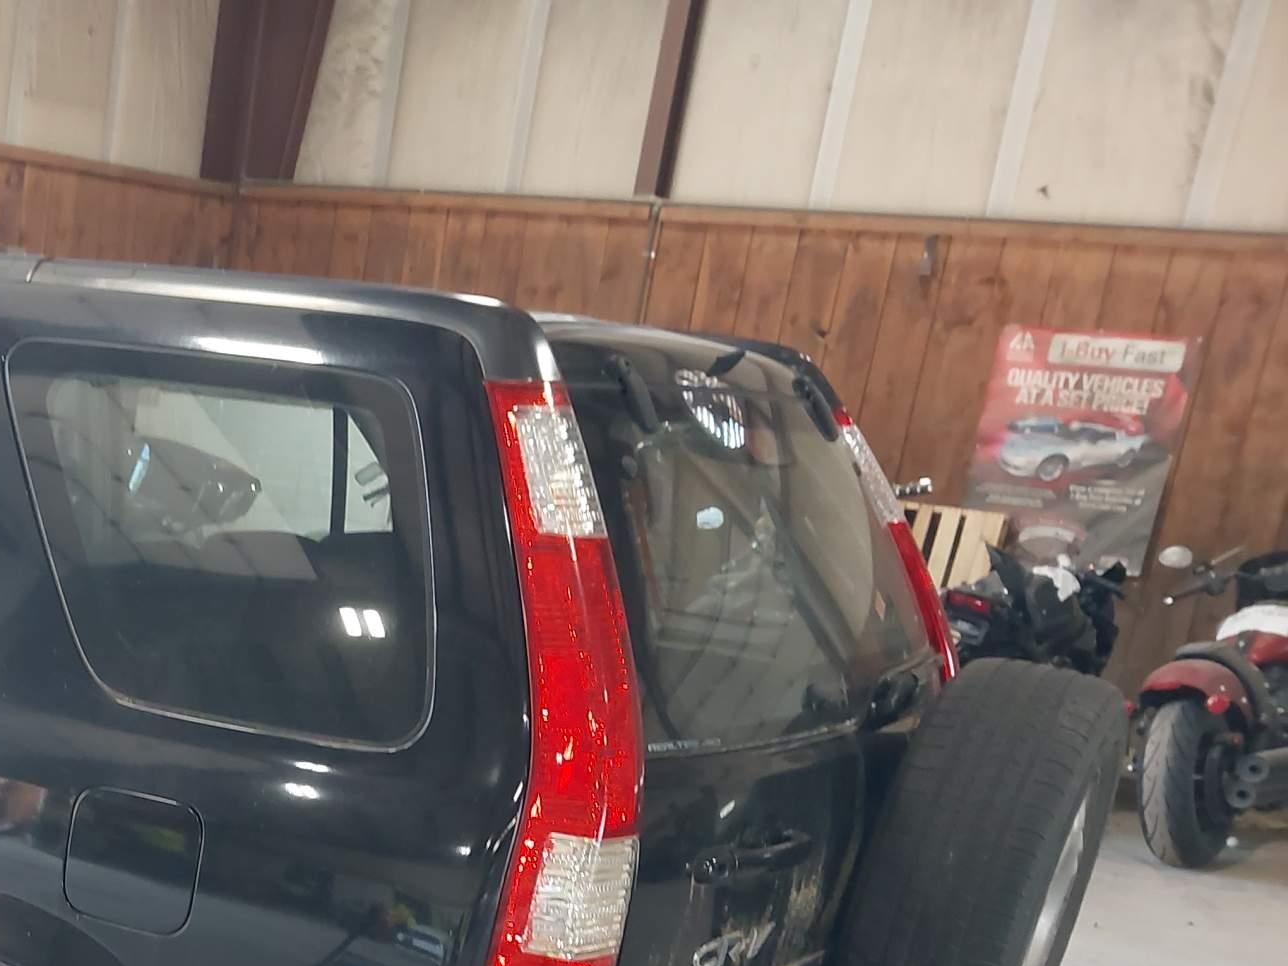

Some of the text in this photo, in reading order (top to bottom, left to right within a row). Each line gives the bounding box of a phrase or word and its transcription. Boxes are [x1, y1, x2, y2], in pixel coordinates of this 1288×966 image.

[1122, 343, 1167, 366] Fast
[1007, 367, 1166, 398] QUALITY VEHICLES
[1015, 384, 1041, 405] AT
[1038, 386, 1055, 407] A
[1056, 389, 1092, 409] SET
